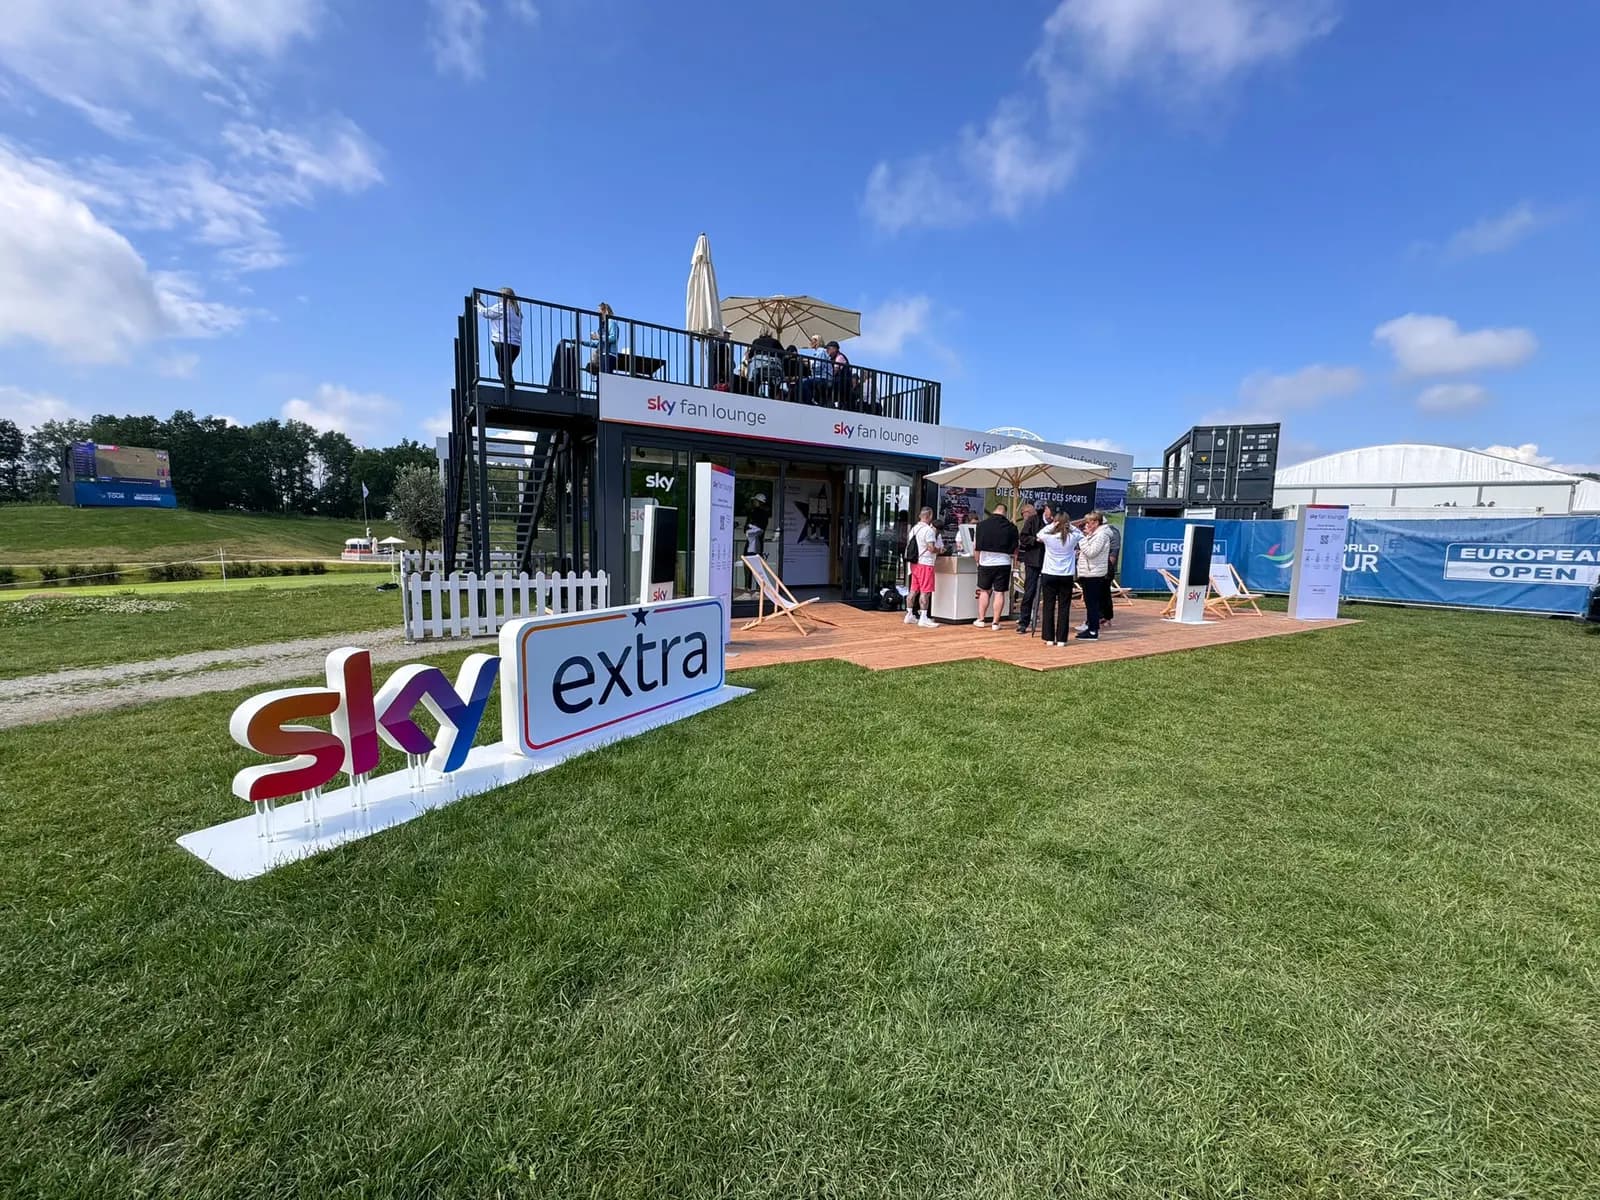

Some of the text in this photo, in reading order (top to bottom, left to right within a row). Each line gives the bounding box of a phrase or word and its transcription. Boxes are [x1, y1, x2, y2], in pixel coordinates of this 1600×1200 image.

[647, 395, 767, 426] sky fan lounge
[833, 421, 919, 447] sky fan lounge
[965, 440, 981, 455] sky
[982, 441, 998, 454] fan
[645, 472, 675, 492] sky
[996, 487, 1088, 504] DIE GNZE WELT DES SPORTS
[1460, 548, 1600, 563] EUROPEA
[1489, 565, 1577, 581] OPEN
[653, 588, 668, 602] sky
[1188, 590, 1202, 603] sky
[230, 631, 708, 801] sky extra
